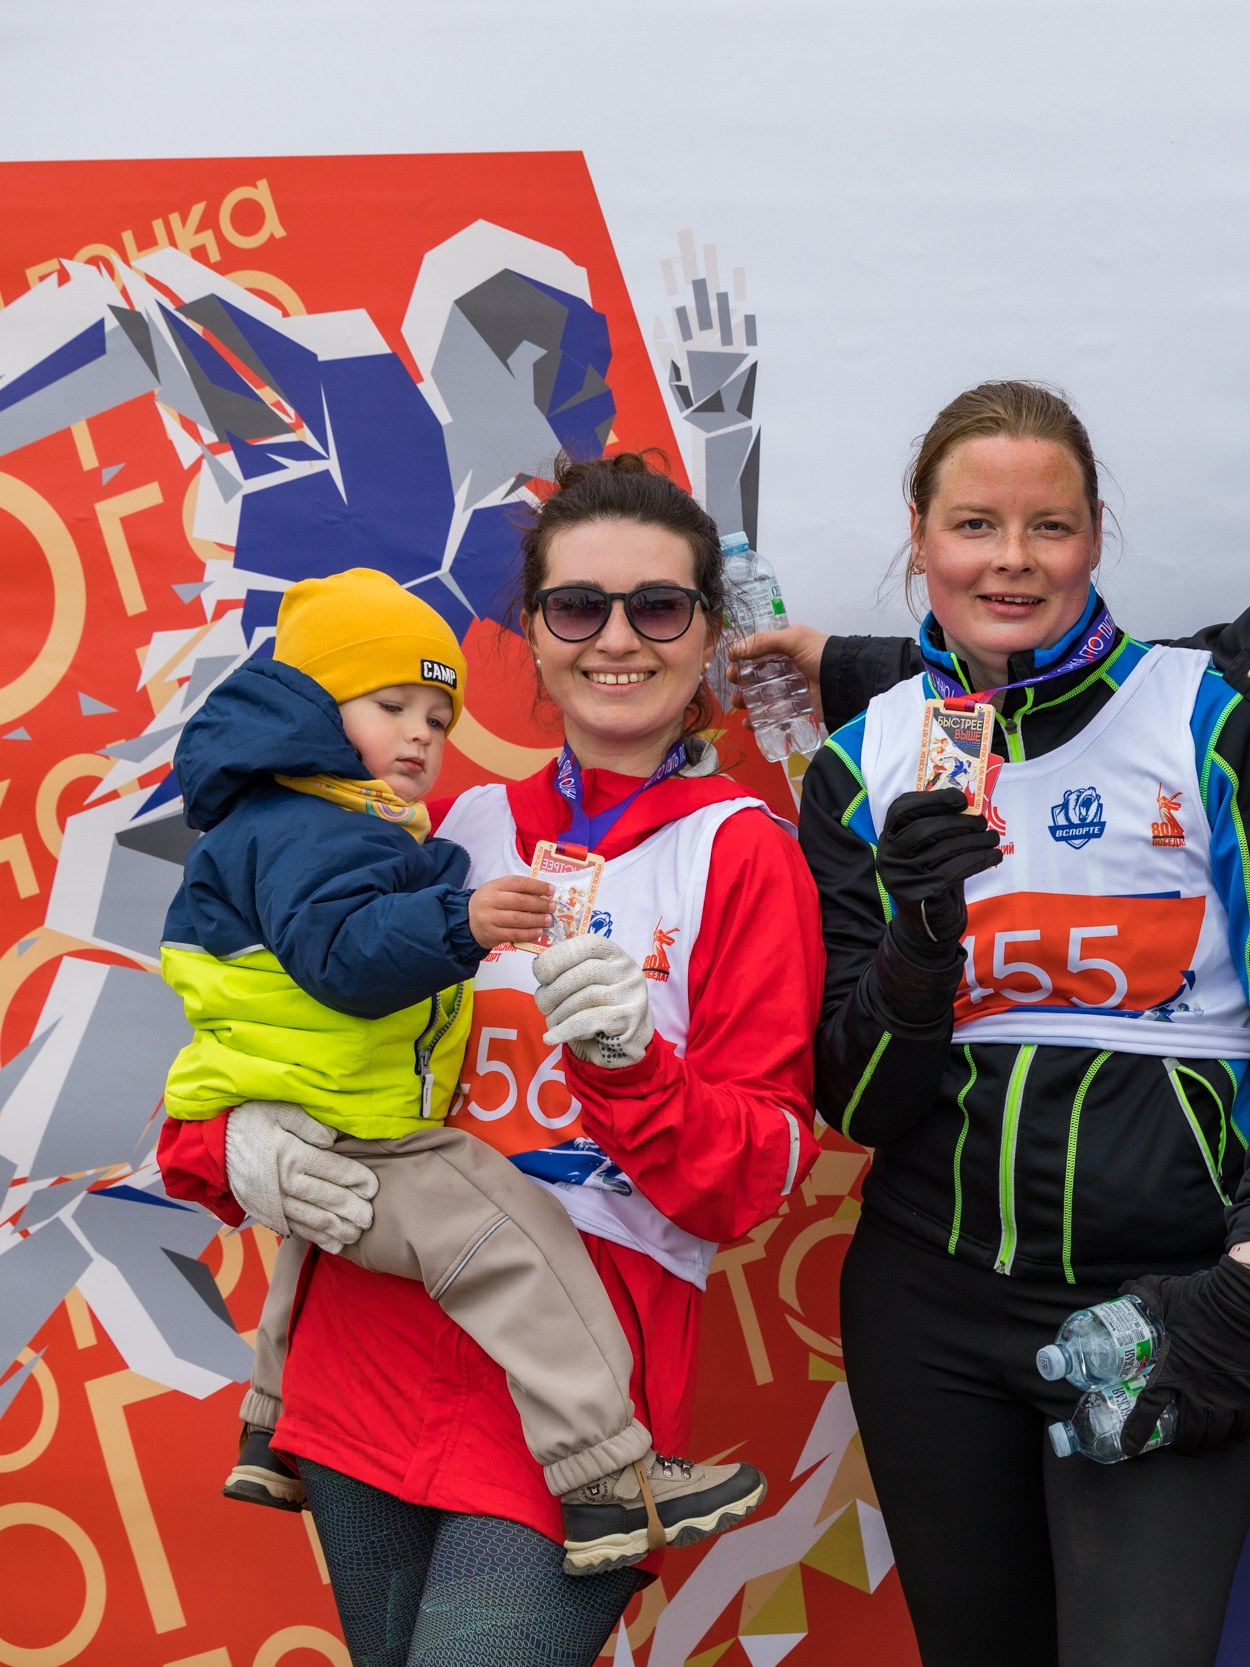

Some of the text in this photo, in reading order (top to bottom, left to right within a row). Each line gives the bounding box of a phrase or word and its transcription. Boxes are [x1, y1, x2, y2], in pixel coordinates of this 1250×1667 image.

[423, 661, 456, 685] CAMP
[938, 716, 983, 731] БЫСТРЕЕ
[954, 730, 982, 742] ВЫШЕ
[1055, 825, 1101, 838] ВСПОРТЕ
[1152, 821, 1168, 836] 80
[1152, 837, 1186, 847] ПОБЕДА!
[644, 954, 658, 969] 80
[450, 1027, 583, 1130] 56
